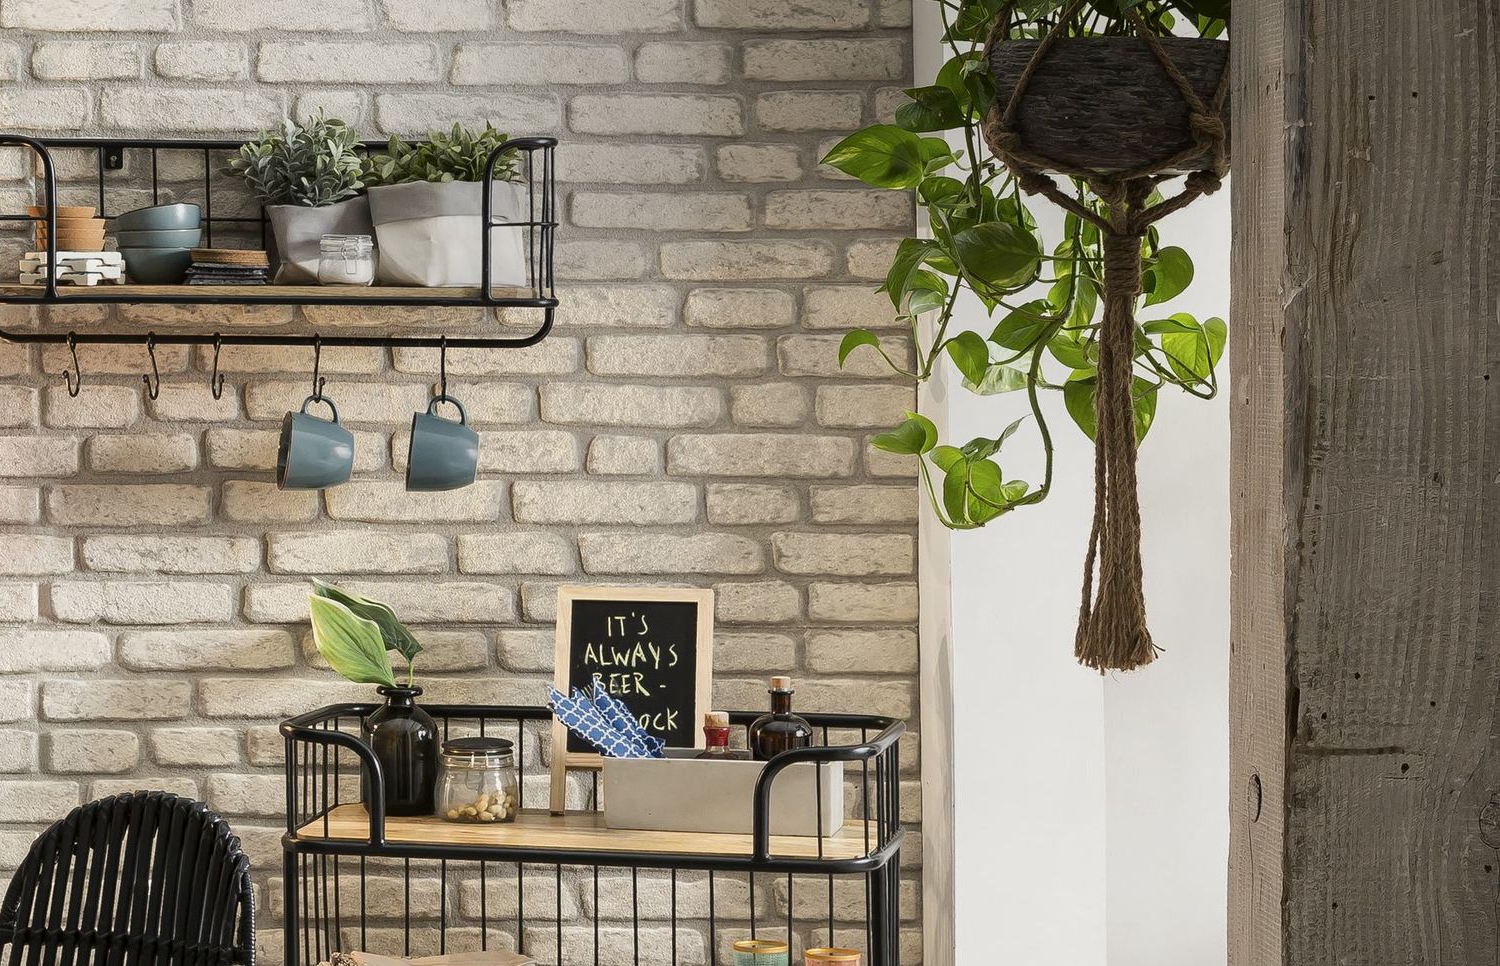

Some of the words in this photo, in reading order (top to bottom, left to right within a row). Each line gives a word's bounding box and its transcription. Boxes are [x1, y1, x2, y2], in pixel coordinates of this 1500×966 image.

[607, 611, 649, 638] IT'S
[584, 642, 679, 670] ALWAYS
[592, 672, 651, 697] BEER
